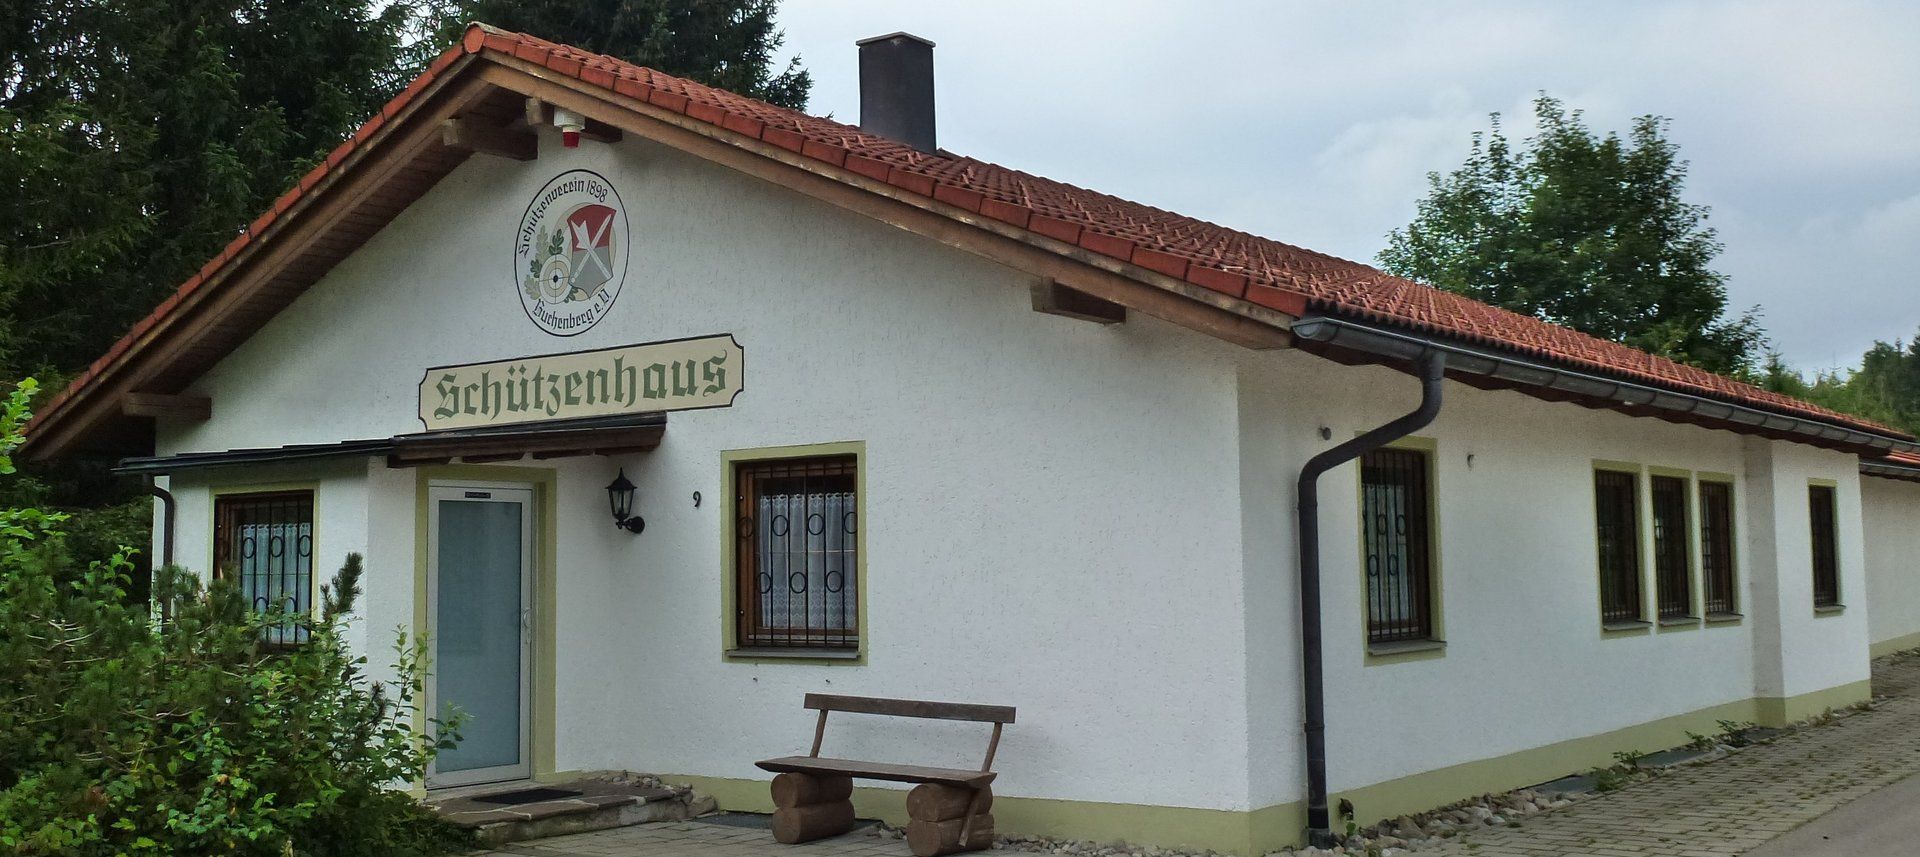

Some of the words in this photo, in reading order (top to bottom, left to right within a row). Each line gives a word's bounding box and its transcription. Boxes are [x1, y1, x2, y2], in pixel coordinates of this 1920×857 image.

[519, 177, 585, 258] Schützenverein
[586, 179, 608, 203] 1898
[532, 298, 595, 330] Buchenberg
[433, 349, 728, 421] Schützenhaus
[692, 490, 702, 509] 9
